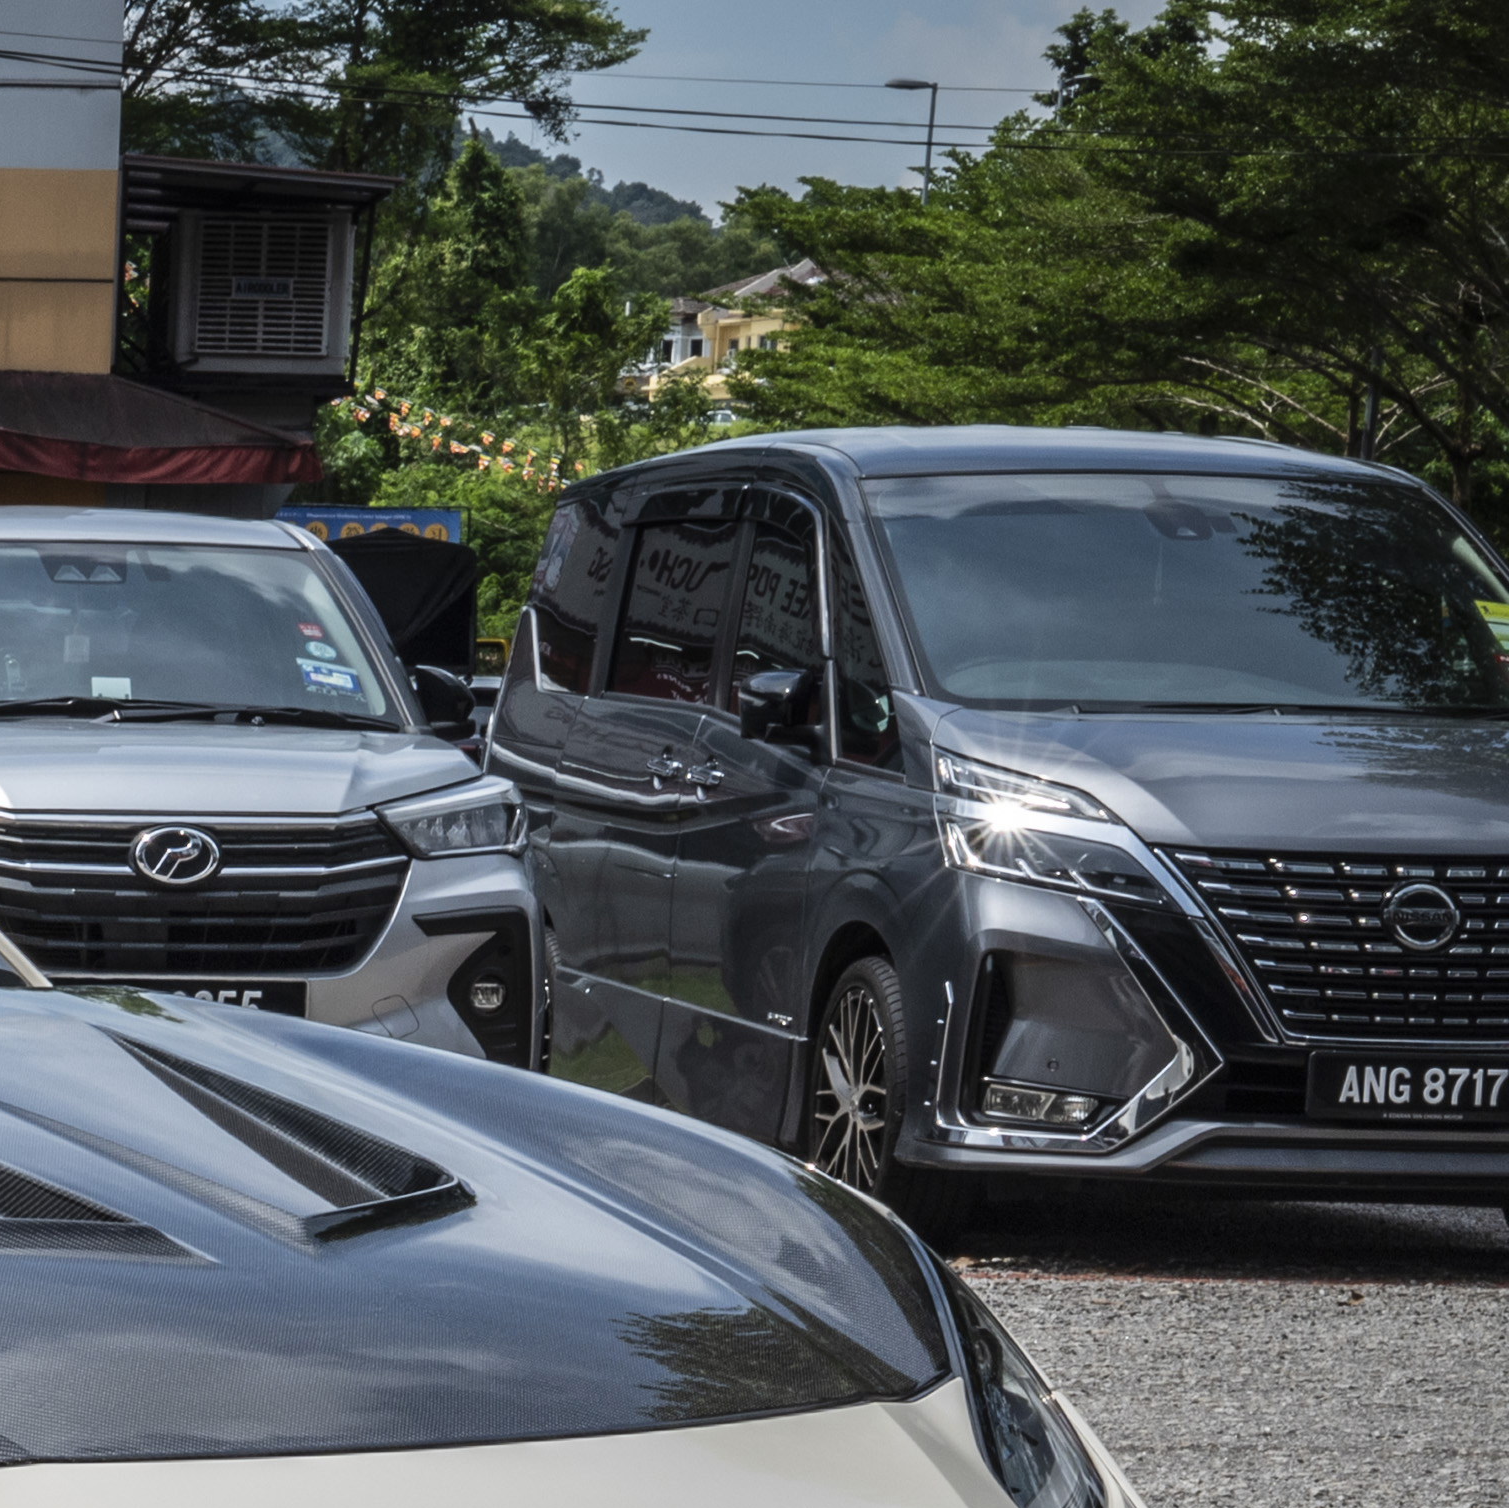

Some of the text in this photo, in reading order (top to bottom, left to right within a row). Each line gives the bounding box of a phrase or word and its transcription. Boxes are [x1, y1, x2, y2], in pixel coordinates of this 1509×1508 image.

[1394, 911, 1452, 924] NISSAN
[1338, 1065, 1509, 1107] ANG 8717
